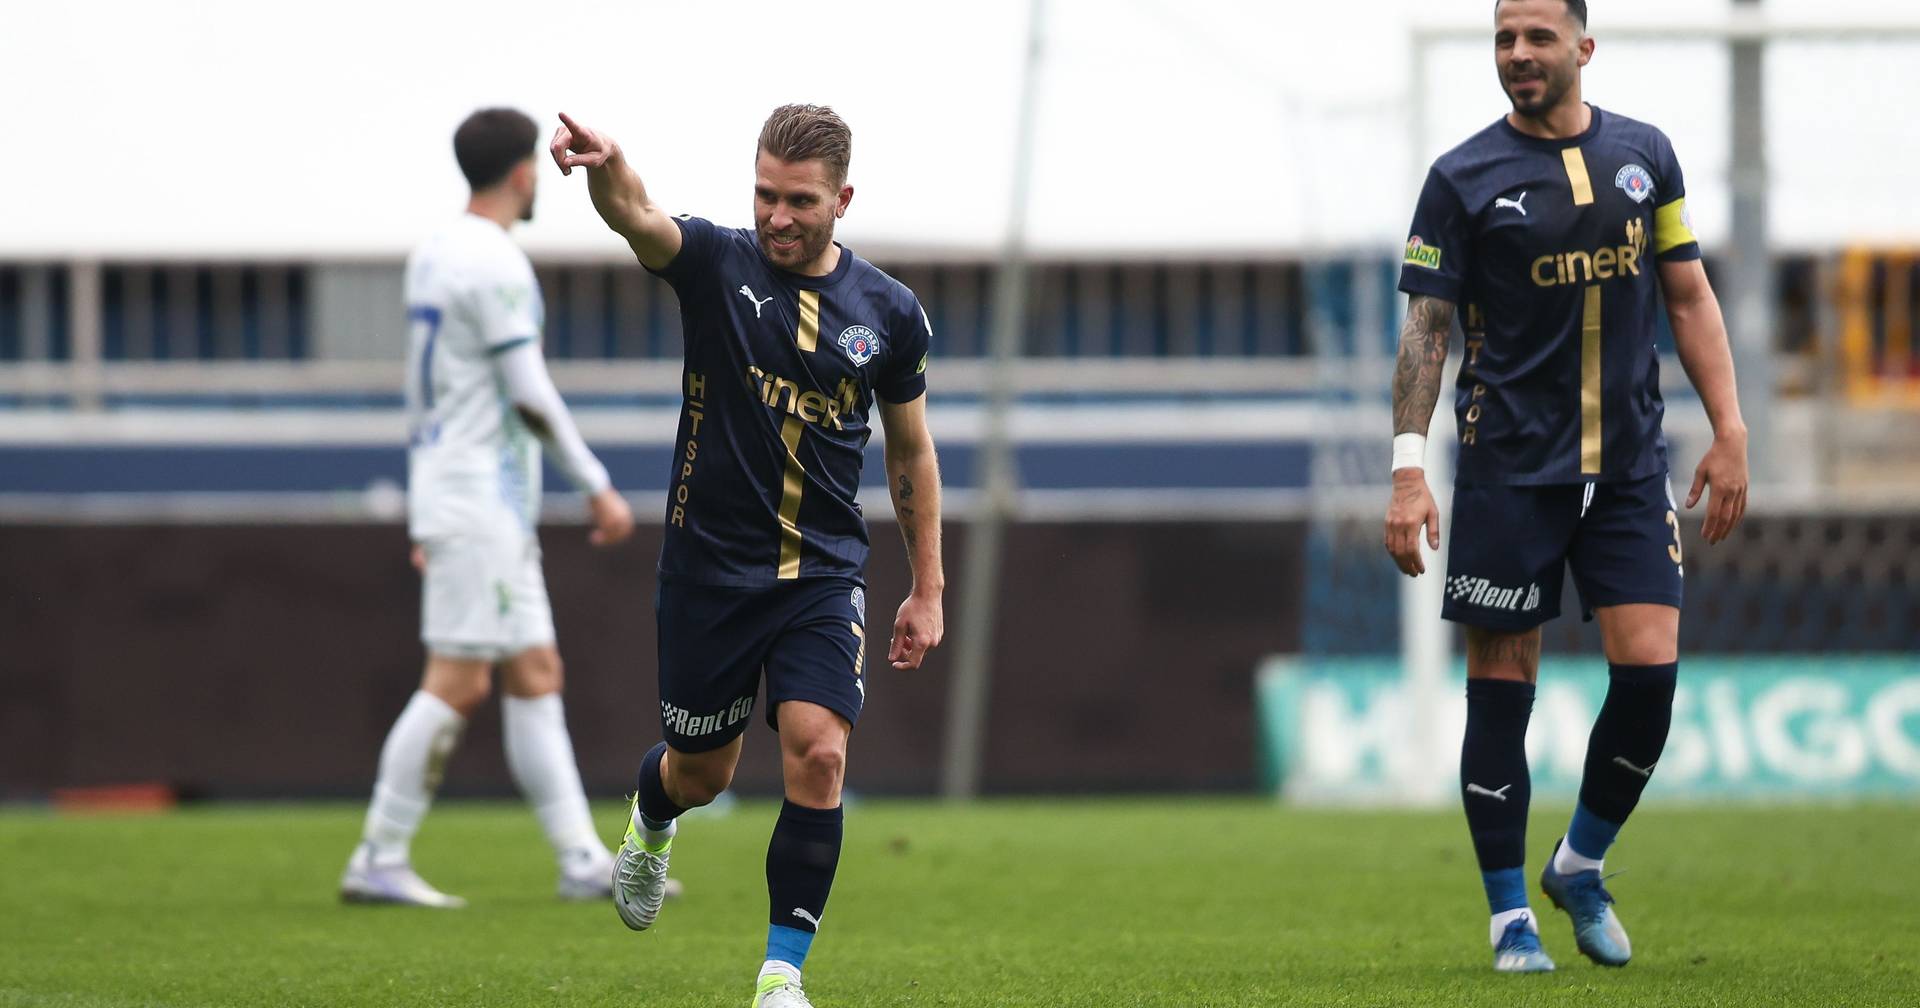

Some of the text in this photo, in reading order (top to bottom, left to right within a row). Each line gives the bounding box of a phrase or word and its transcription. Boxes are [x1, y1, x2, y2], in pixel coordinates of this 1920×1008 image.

[1468, 578, 1523, 611] Rent
[851, 621, 865, 675] 7
[674, 696, 753, 737] Rent Go
